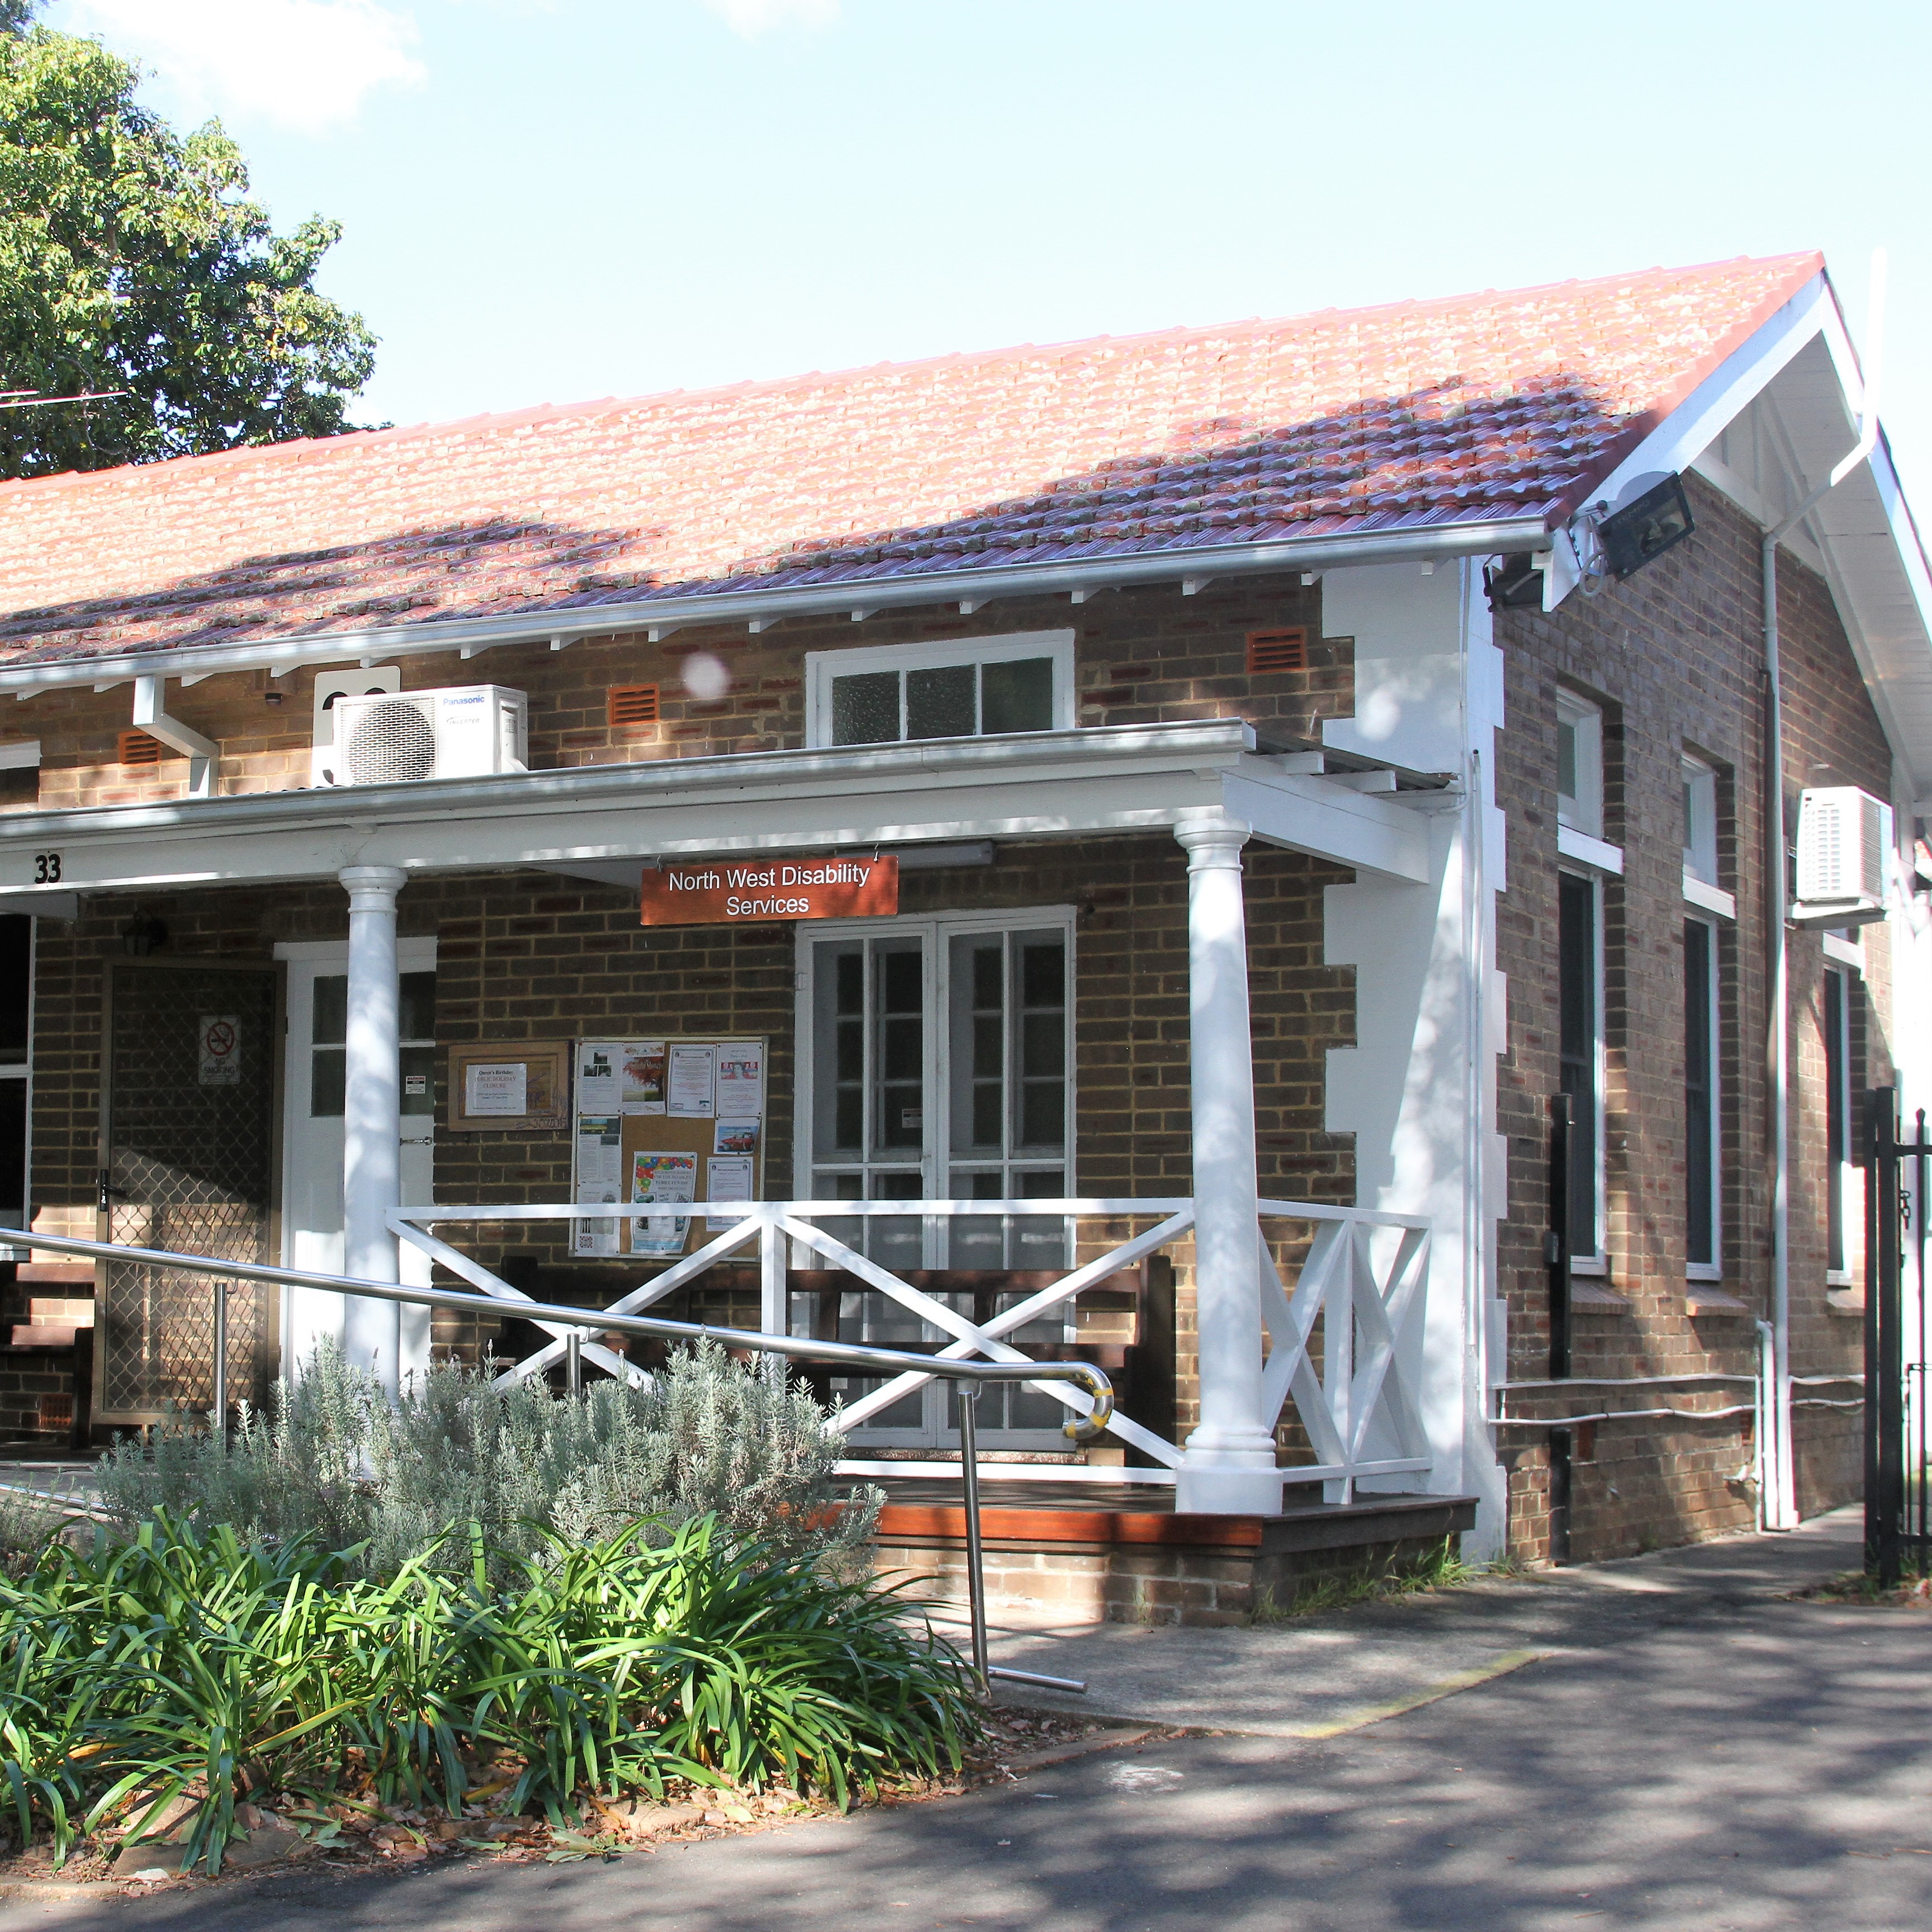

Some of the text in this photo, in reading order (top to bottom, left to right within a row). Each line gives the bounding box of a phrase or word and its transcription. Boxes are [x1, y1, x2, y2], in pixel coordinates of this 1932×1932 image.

[443, 695, 485, 705] Panasonic
[34, 854, 61, 884] 33
[669, 864, 870, 891] North West Disability
[726, 895, 809, 916] Services
